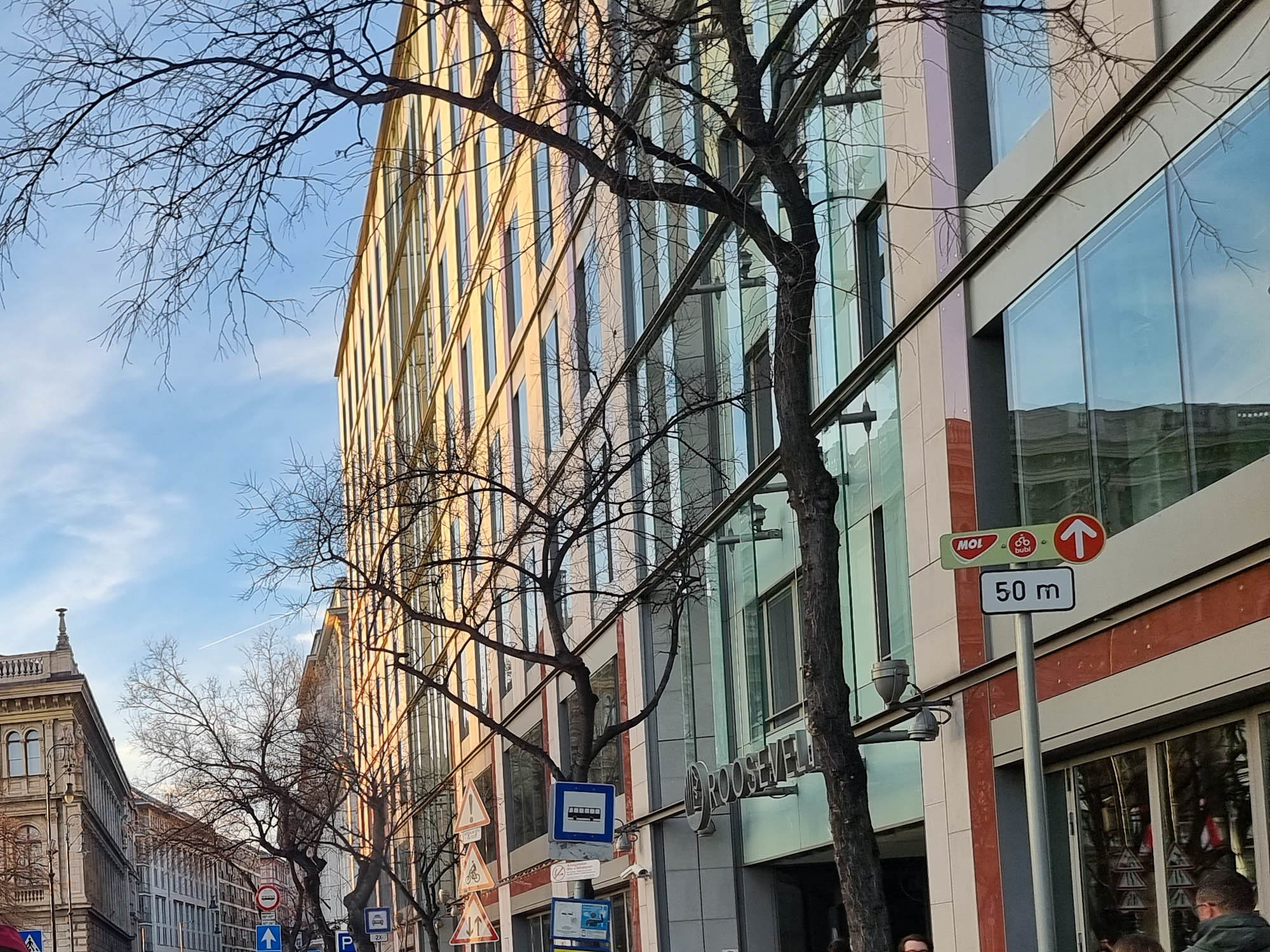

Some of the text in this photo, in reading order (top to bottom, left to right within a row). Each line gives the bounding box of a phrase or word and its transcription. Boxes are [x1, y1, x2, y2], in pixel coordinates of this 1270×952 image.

[957, 538, 984, 550] MOL
[1015, 546, 1031, 554] bubi
[995, 580, 1060, 602] 50 m
